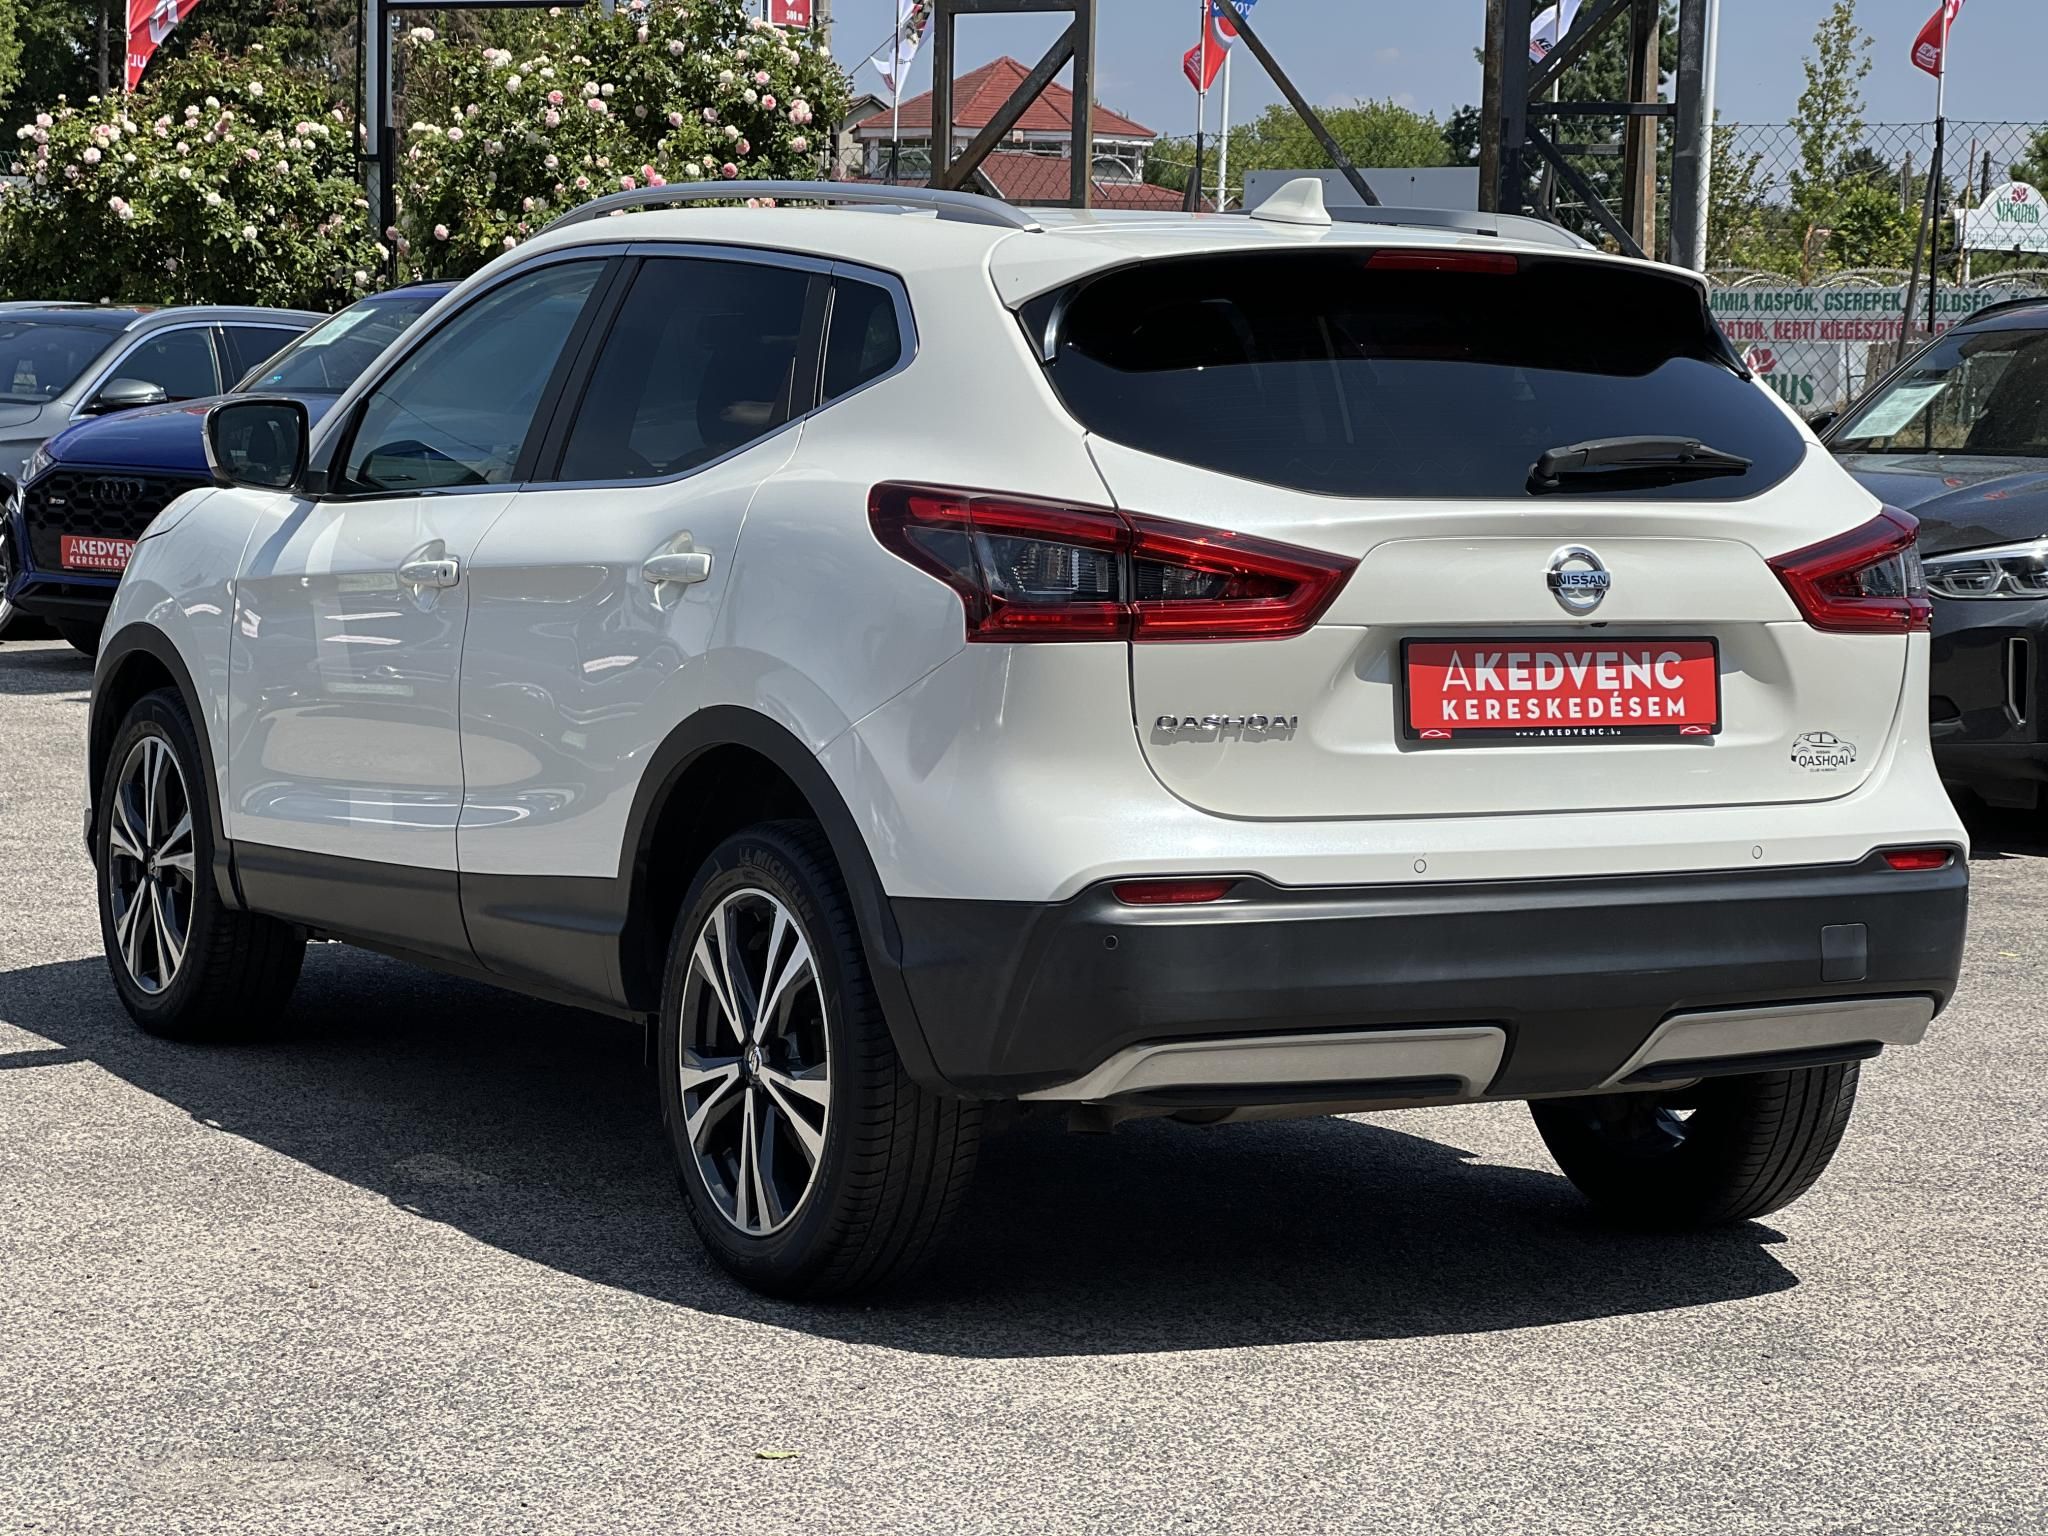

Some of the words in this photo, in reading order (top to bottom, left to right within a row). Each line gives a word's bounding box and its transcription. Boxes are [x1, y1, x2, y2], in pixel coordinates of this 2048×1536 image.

[1754, 289, 1818, 313] KASPÓK,
[1556, 575, 1606, 585] NISSAN
[1442, 650, 1685, 692] AKEDVENC
[1442, 692, 1686, 721] KERESKEDÉSEM
[1155, 714, 1298, 734] QASHQAI
[1798, 755, 1848, 768] QASHQAI
